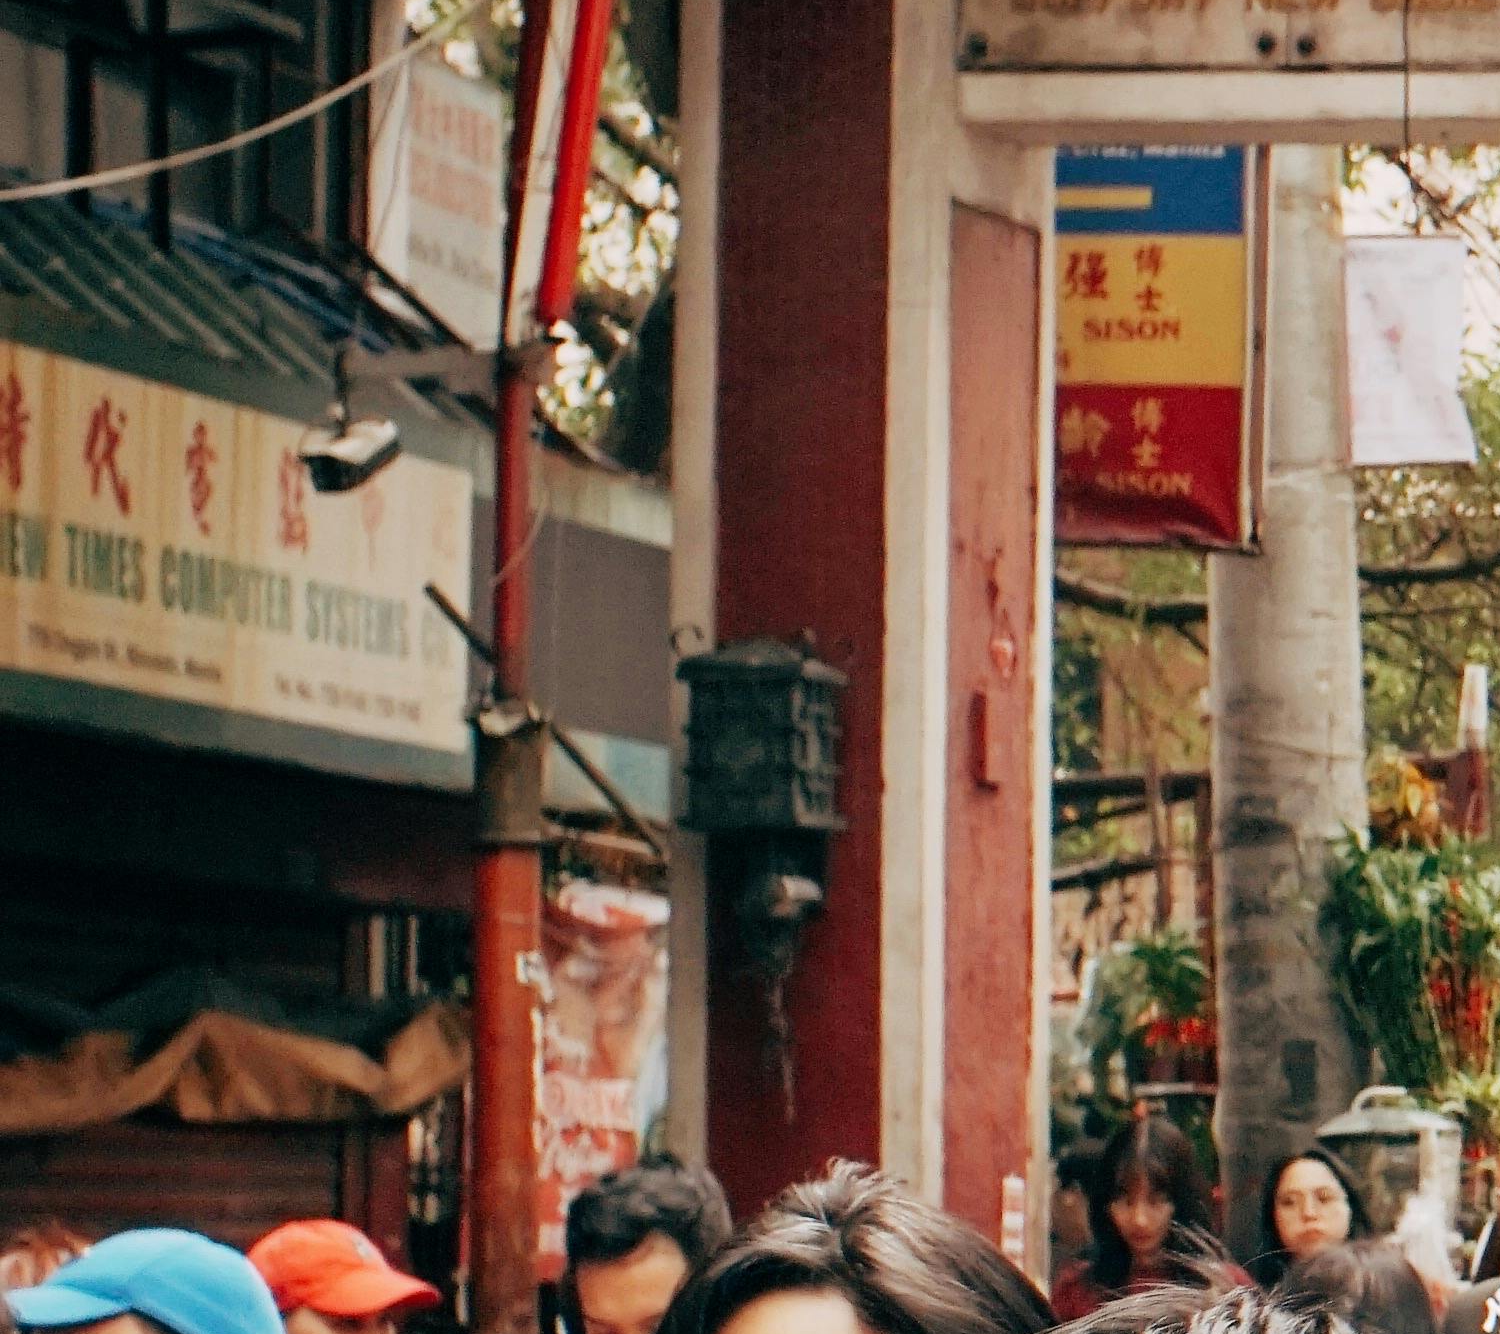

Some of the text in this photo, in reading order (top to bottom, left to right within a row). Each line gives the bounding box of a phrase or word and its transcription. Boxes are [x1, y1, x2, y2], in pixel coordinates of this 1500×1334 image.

[1083, 319, 1181, 342] SISON
[64, 522, 146, 605] TIMES
[158, 542, 293, 637] COMPUTER
[304, 577, 410, 662] SYSTEMS
